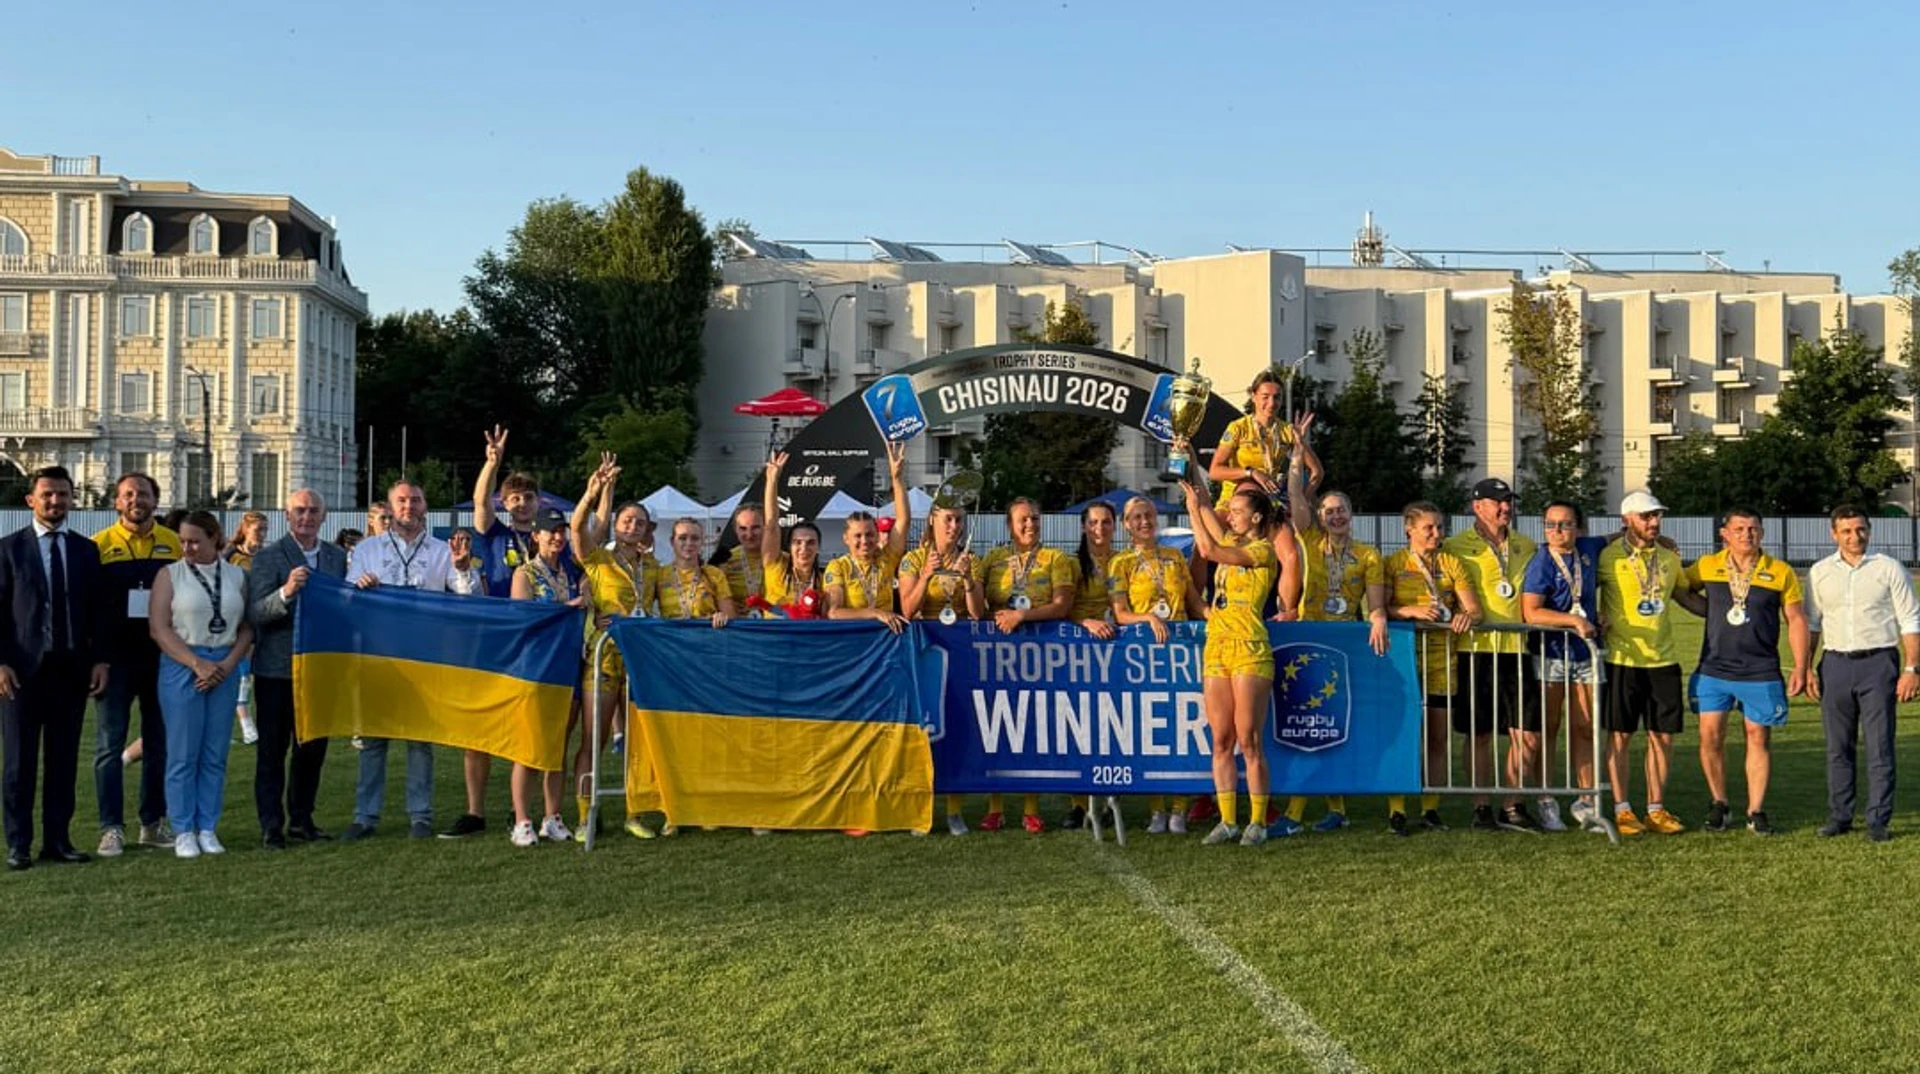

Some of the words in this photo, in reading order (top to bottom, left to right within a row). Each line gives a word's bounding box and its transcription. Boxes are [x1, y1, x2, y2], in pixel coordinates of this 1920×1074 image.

[993, 354, 1036, 369] TROPHY
[1037, 354, 1076, 369] SERIES
[938, 374, 1059, 414] CHISINAU
[1065, 375, 1130, 414] 2026
[1059, 622, 1144, 638] EUPE
[972, 642, 1114, 683] TROPHY
[1125, 643, 1202, 684] SERI
[972, 689, 1243, 756] WINNER
[1287, 713, 1335, 727] rugby
[1282, 728, 1340, 740] europe
[1092, 766, 1133, 784] 2026
